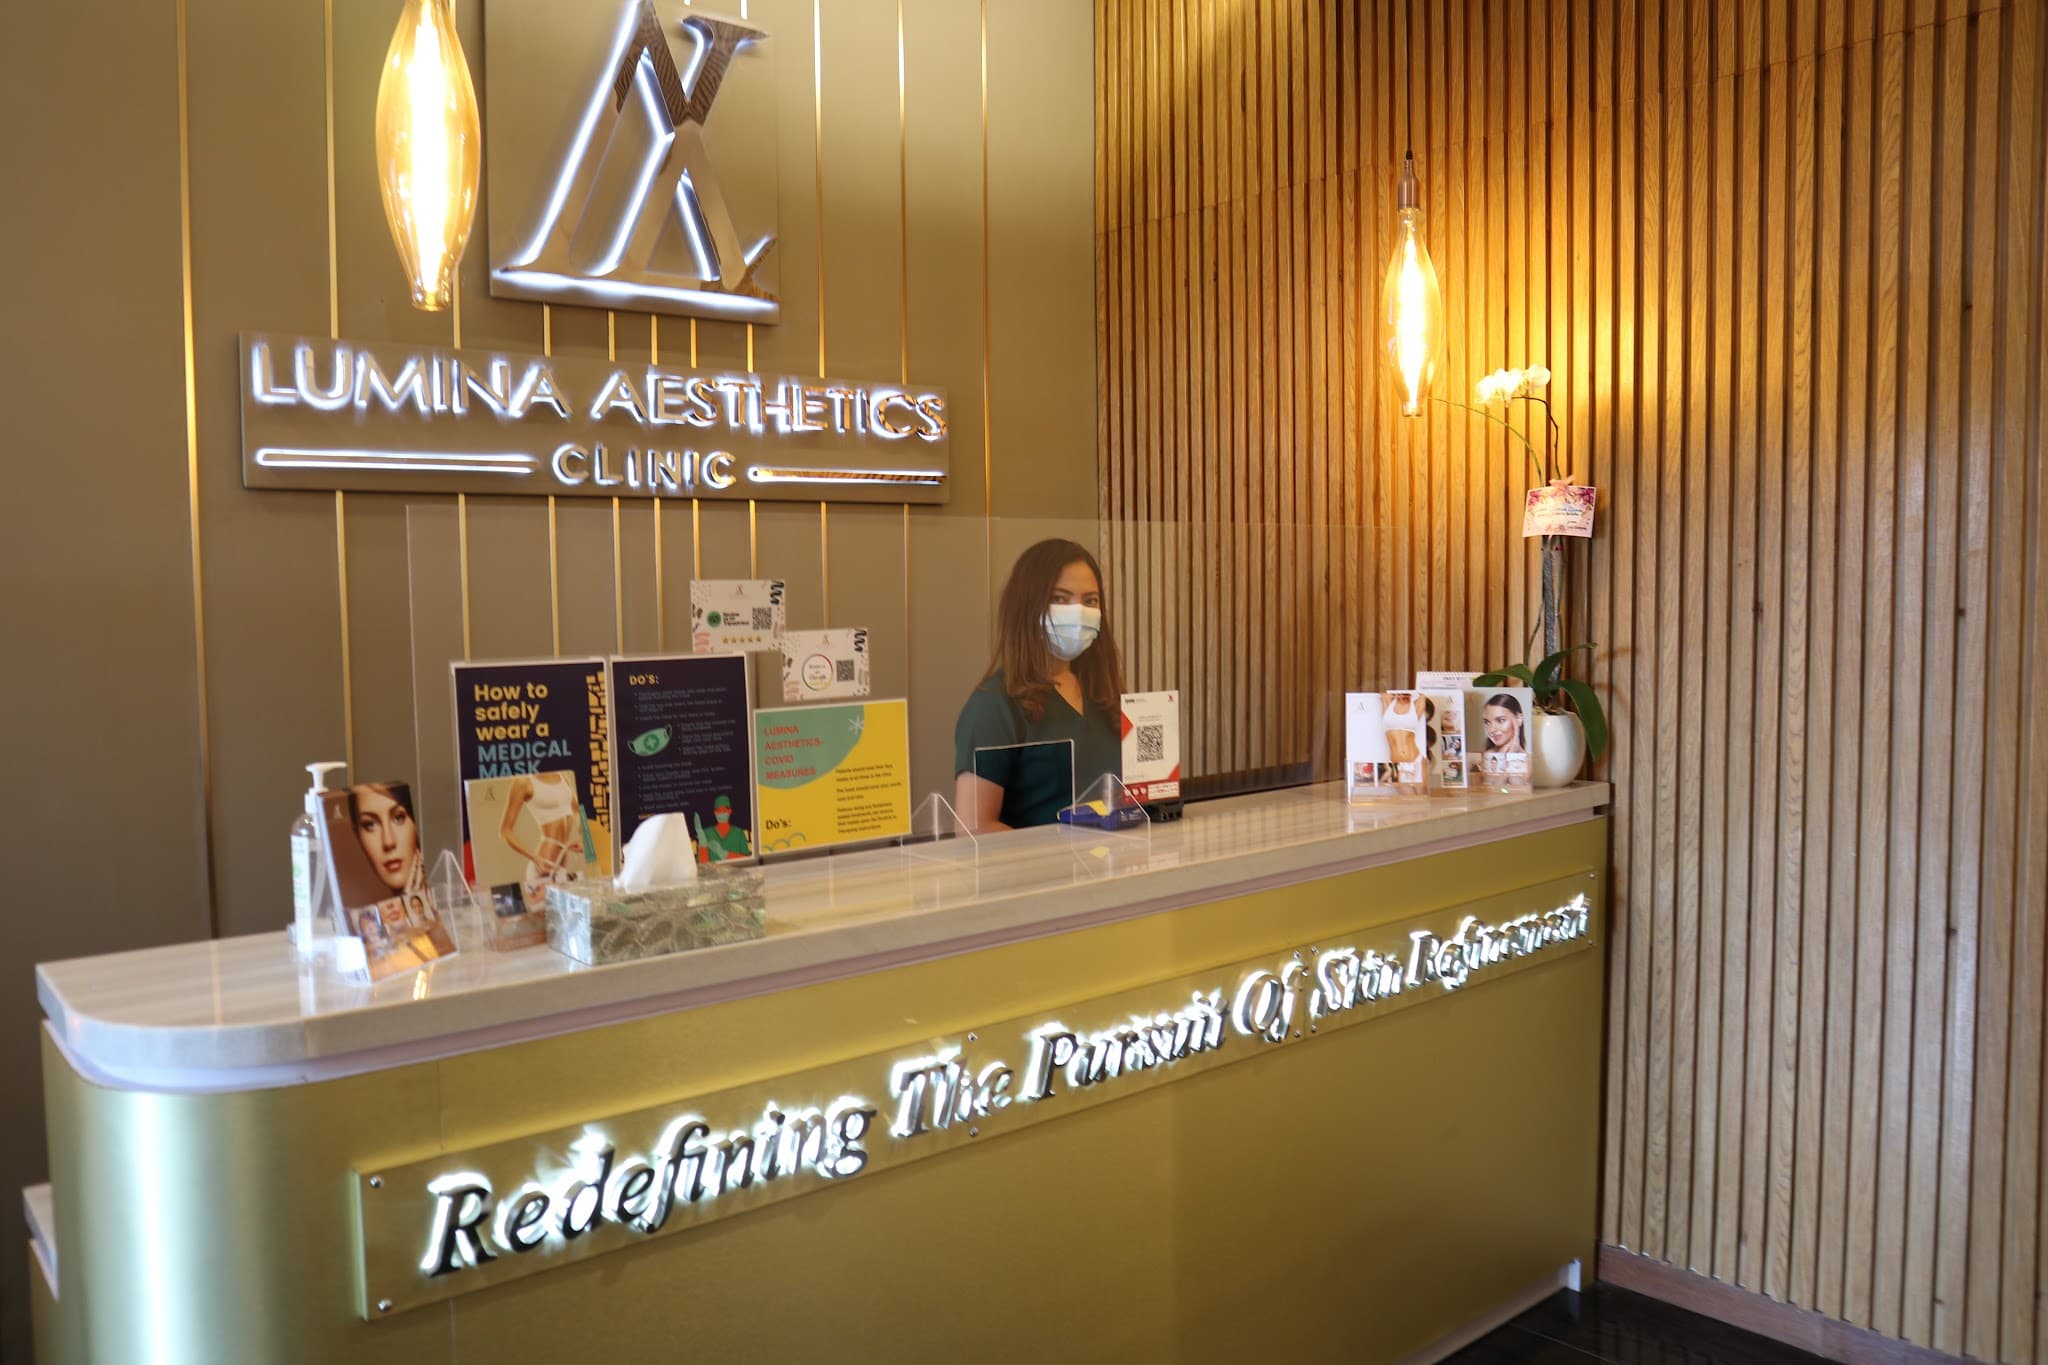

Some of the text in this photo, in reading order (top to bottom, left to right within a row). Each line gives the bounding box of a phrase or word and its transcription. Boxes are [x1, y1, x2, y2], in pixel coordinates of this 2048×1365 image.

[251, 343, 948, 440] LUMINA AESTHETICS
[551, 443, 737, 488] CLINIC
[629, 674, 660, 686] DO'S:
[473, 682, 548, 702] How to
[474, 701, 540, 724] safely
[475, 722, 550, 741] wear a
[764, 725, 799, 737] LUMINA
[477, 738, 572, 763] MEDICAL
[478, 760, 542, 778] MASK
[764, 755, 794, 766] COVID
[765, 767, 817, 781] MEASURES
[765, 818, 792, 830] Do's:
[420, 895, 1592, 1278] Redefining The Pursuit Of Skin Refinement
